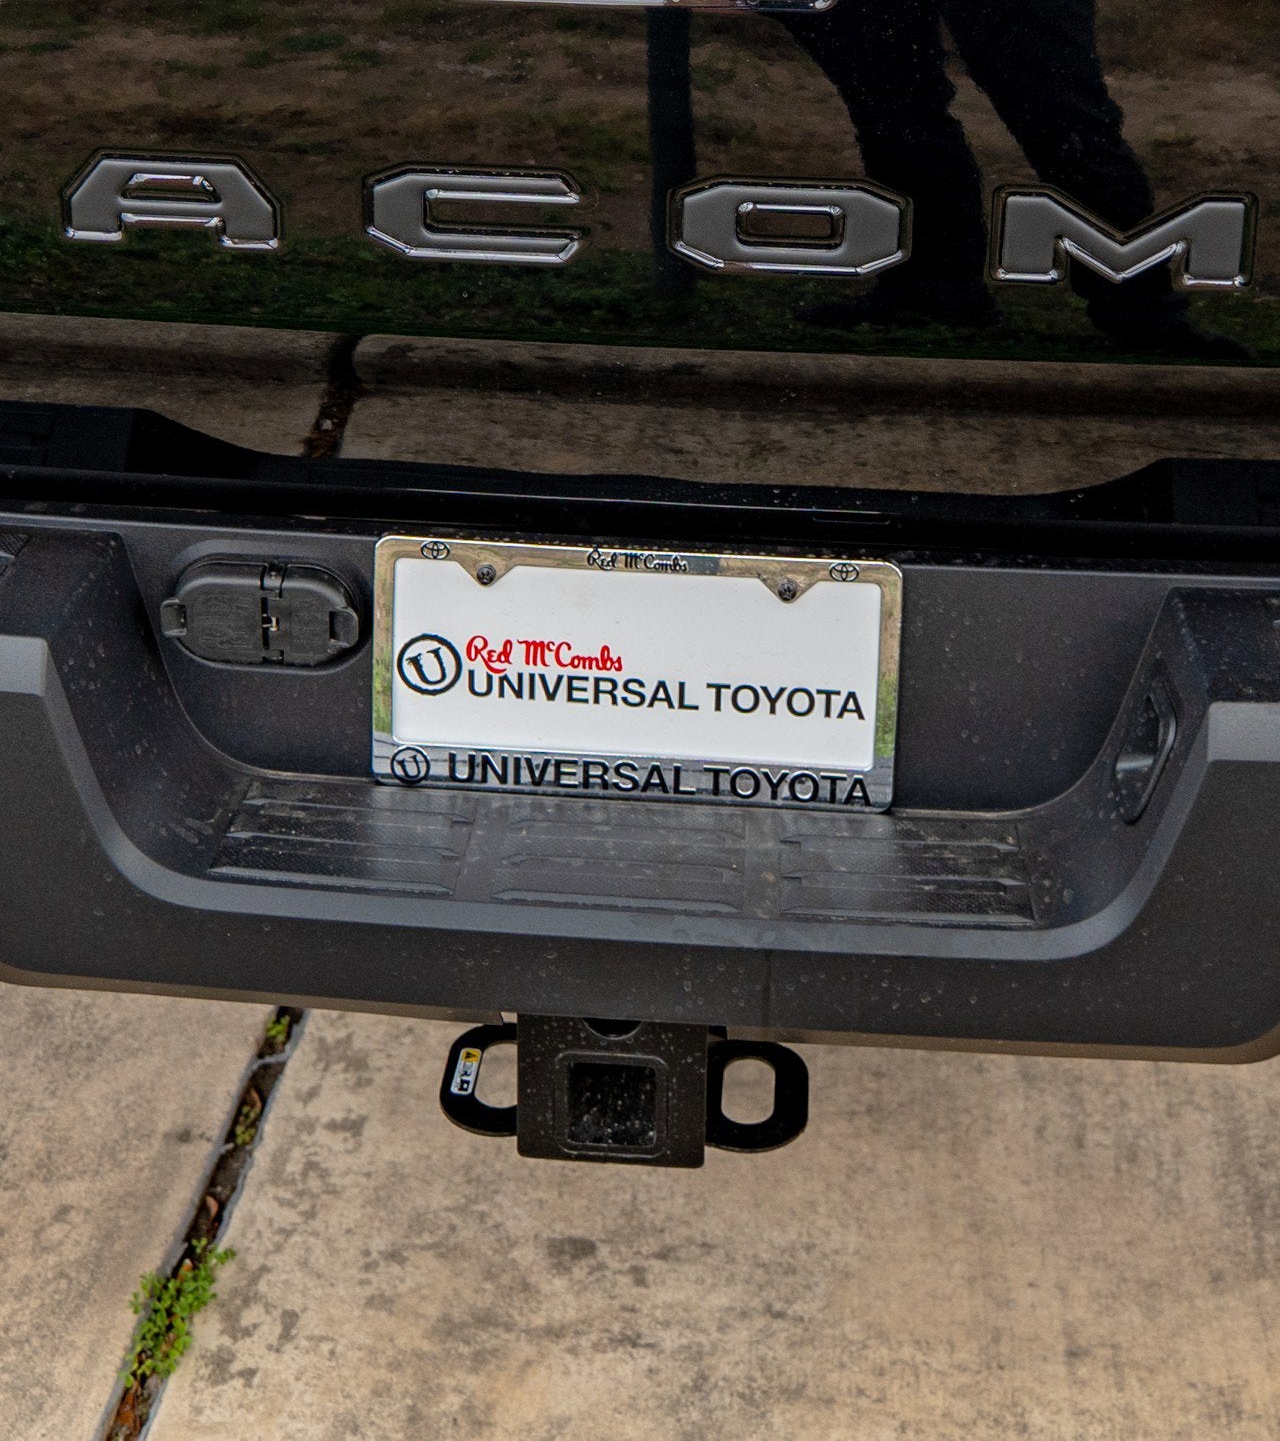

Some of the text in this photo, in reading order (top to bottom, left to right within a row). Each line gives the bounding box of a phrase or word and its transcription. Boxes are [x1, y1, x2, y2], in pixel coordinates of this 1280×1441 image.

[587, 547, 618, 569] Red
[466, 635, 623, 674] Red McCombs
[467, 672, 866, 721] UNIVERSAL TOYOTA
[449, 752, 872, 807] UNIVERSAL TOYOTA
